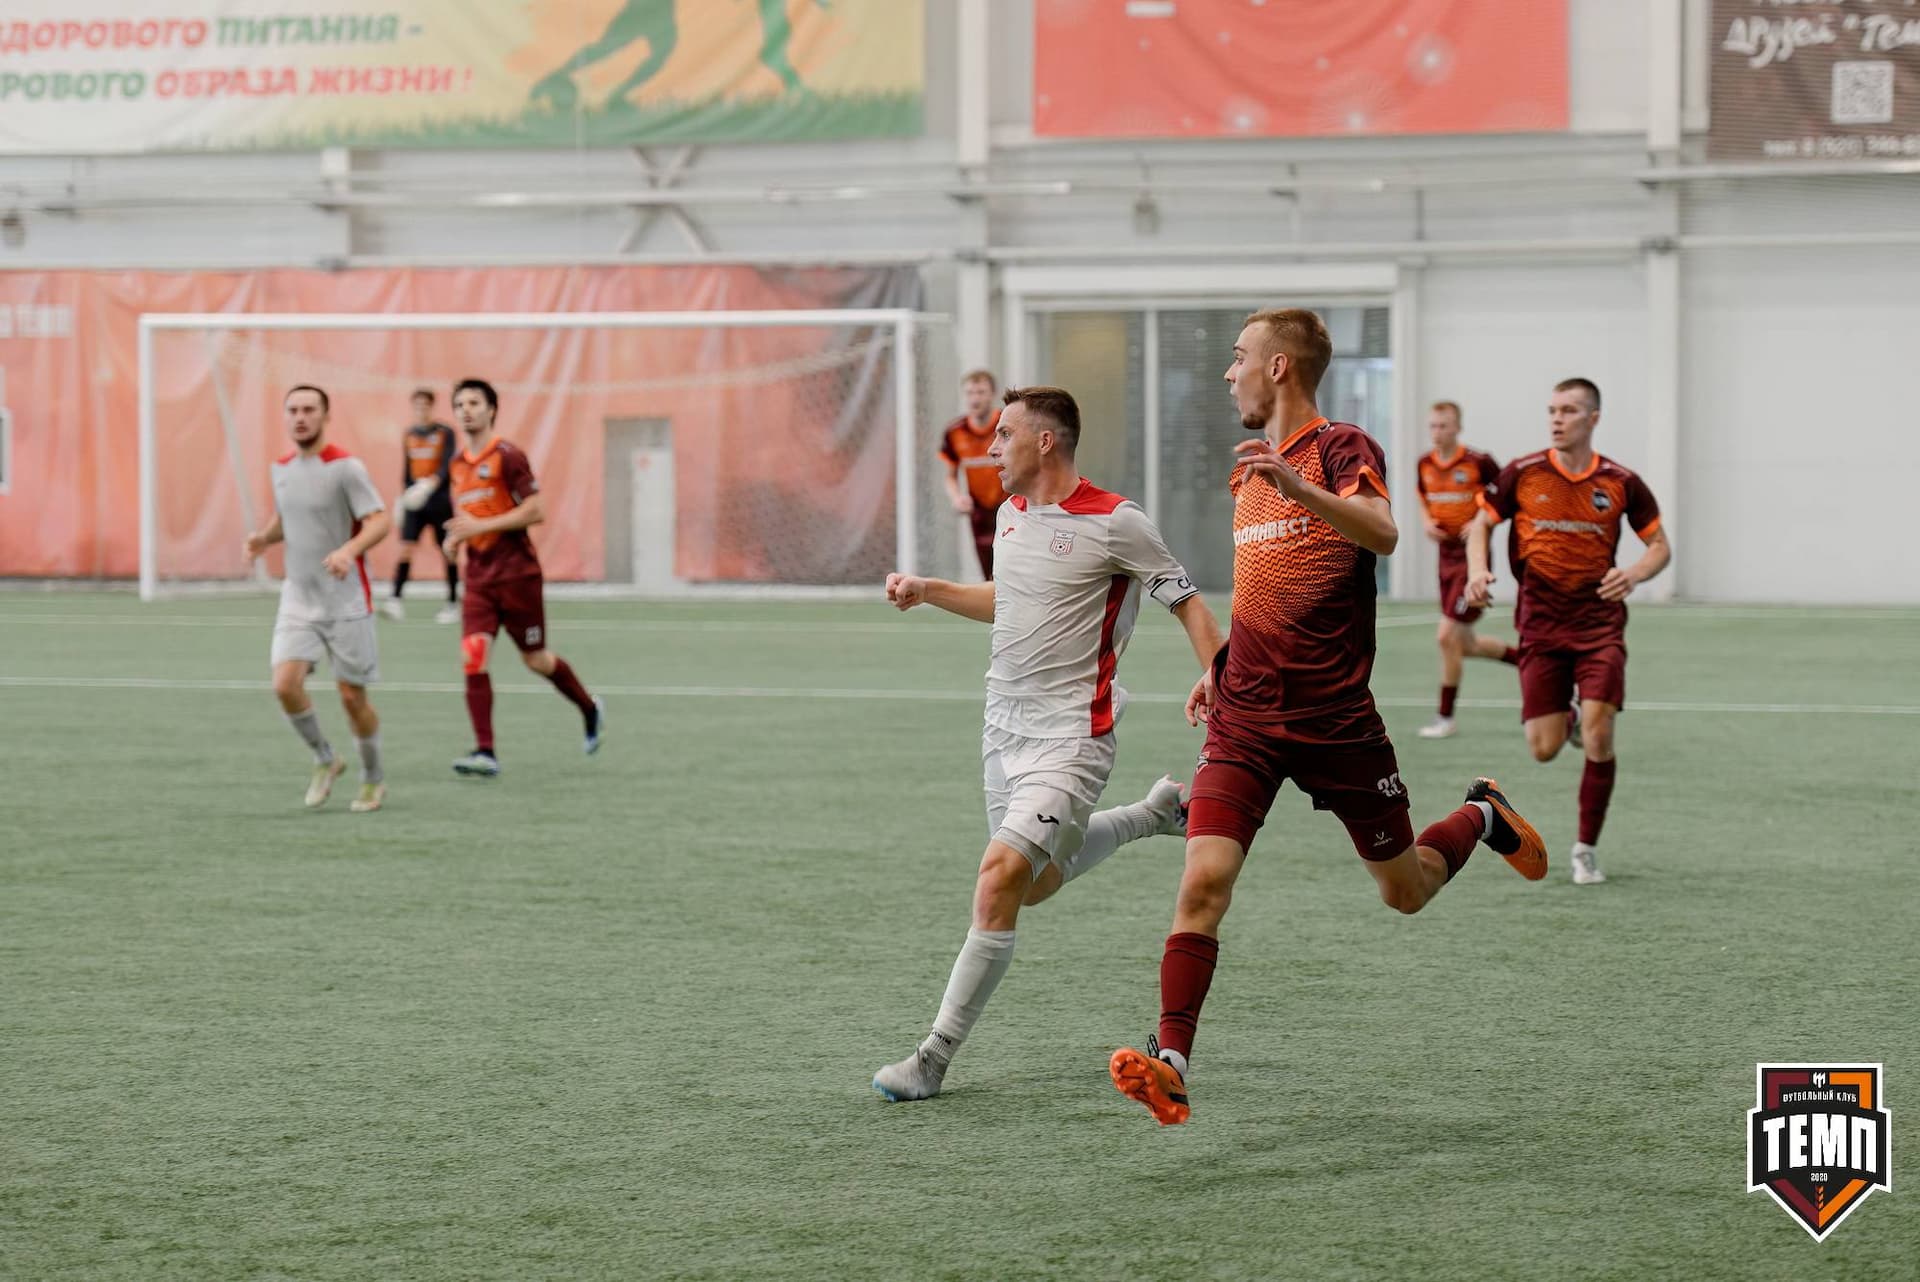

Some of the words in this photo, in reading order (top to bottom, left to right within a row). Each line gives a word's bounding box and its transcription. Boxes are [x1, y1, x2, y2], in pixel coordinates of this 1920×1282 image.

[0, 19, 207, 54] ДОРОВОГО
[217, 15, 400, 46] ПИТАНИЯ
[154, 69, 297, 99] ОБРАЗА
